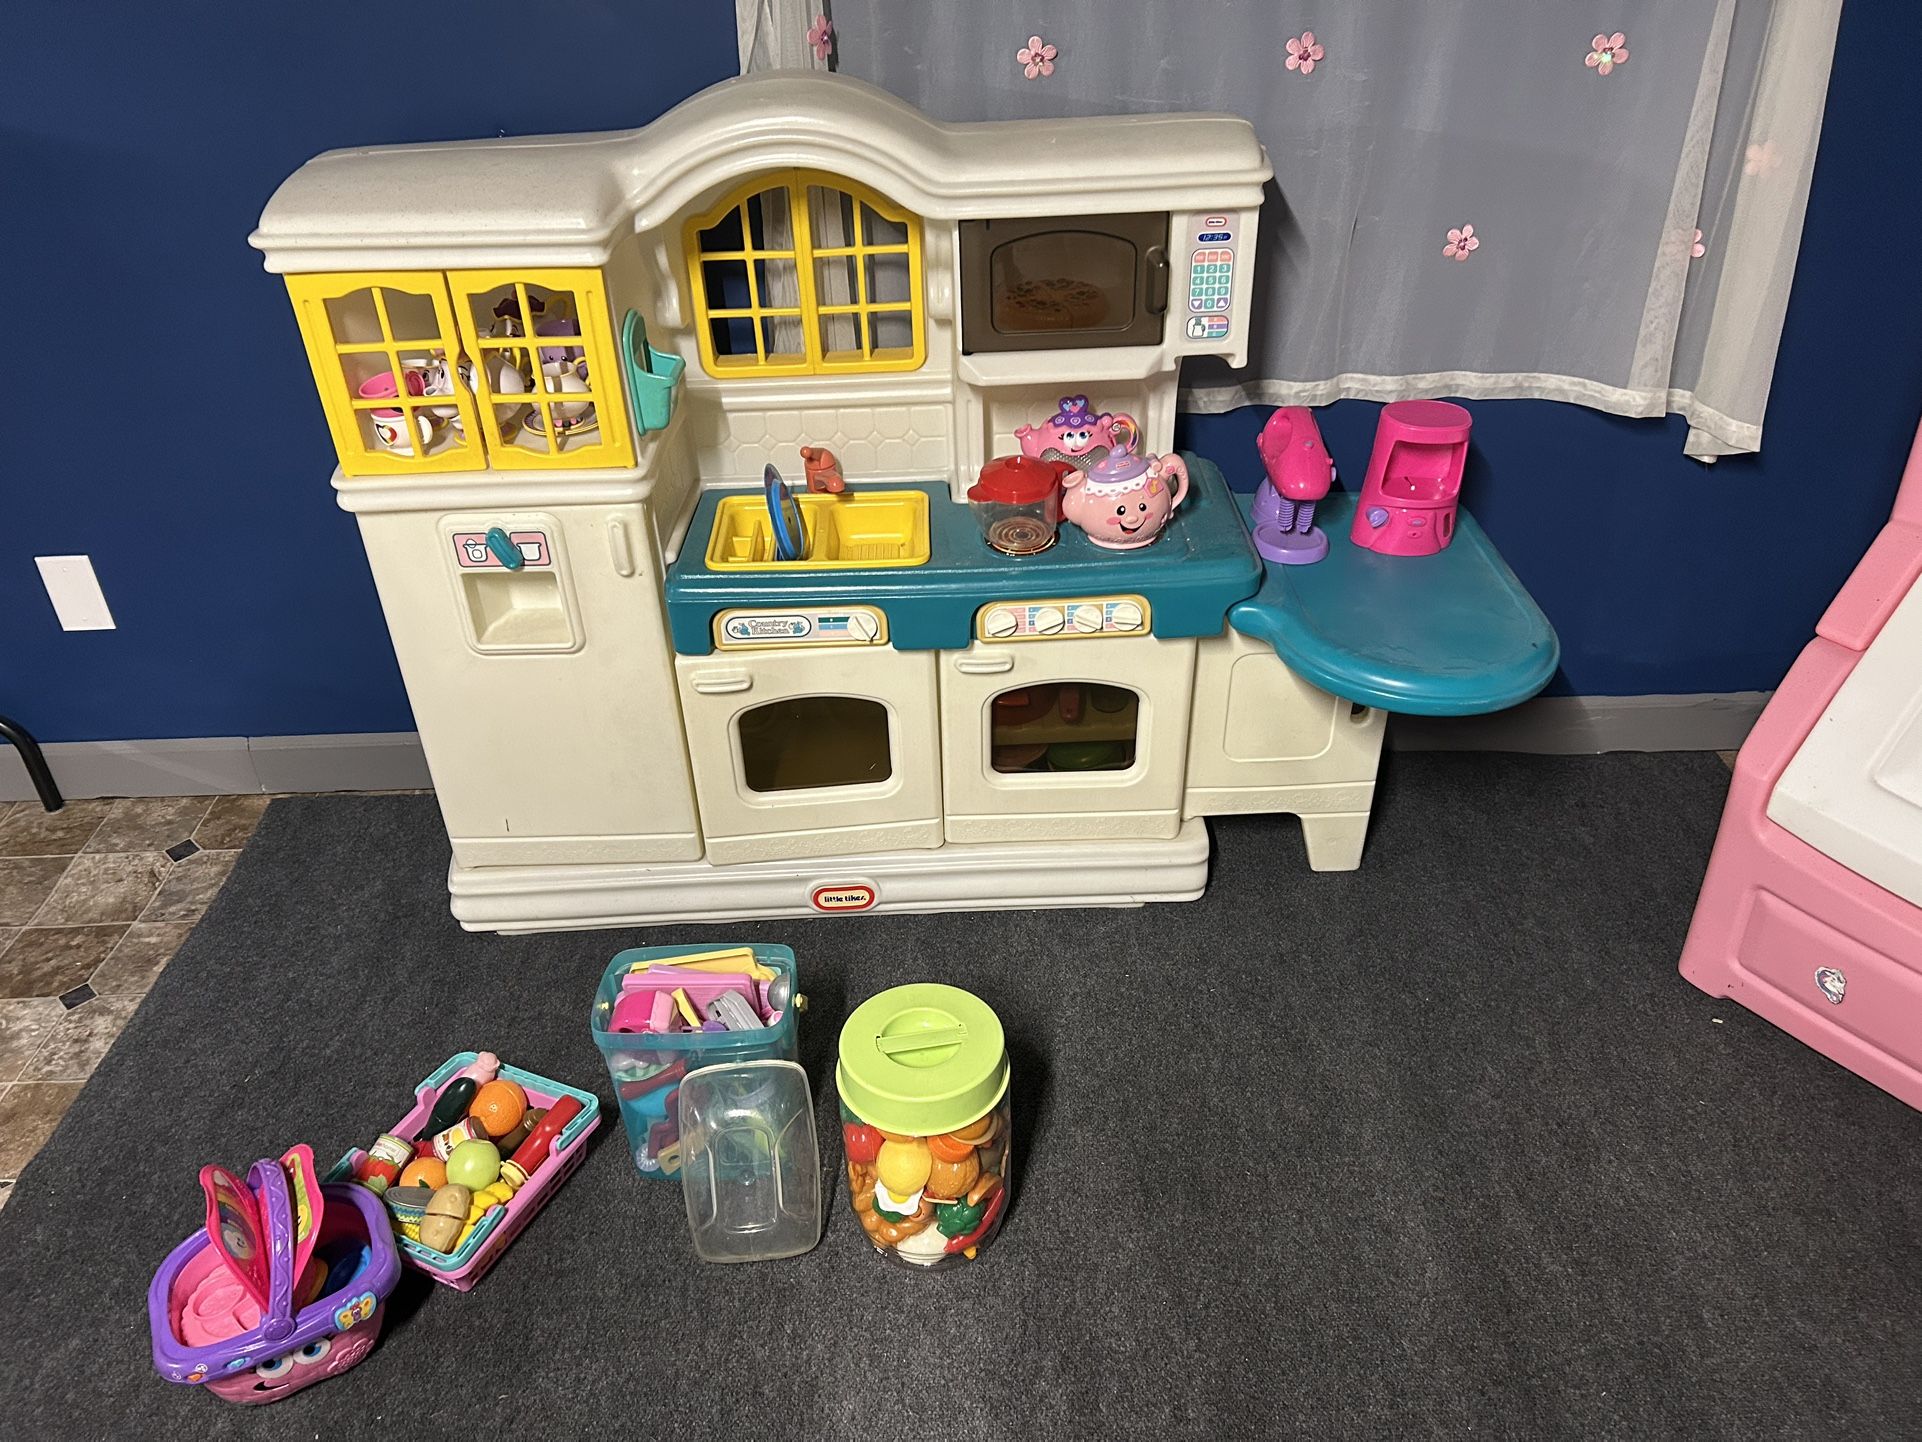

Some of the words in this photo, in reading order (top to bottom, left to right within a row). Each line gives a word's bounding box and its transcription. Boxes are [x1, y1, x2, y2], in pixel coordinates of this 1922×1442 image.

[748, 619, 788, 628] Country
[752, 627, 790, 635] Kitchen
[824, 895, 843, 903] little
